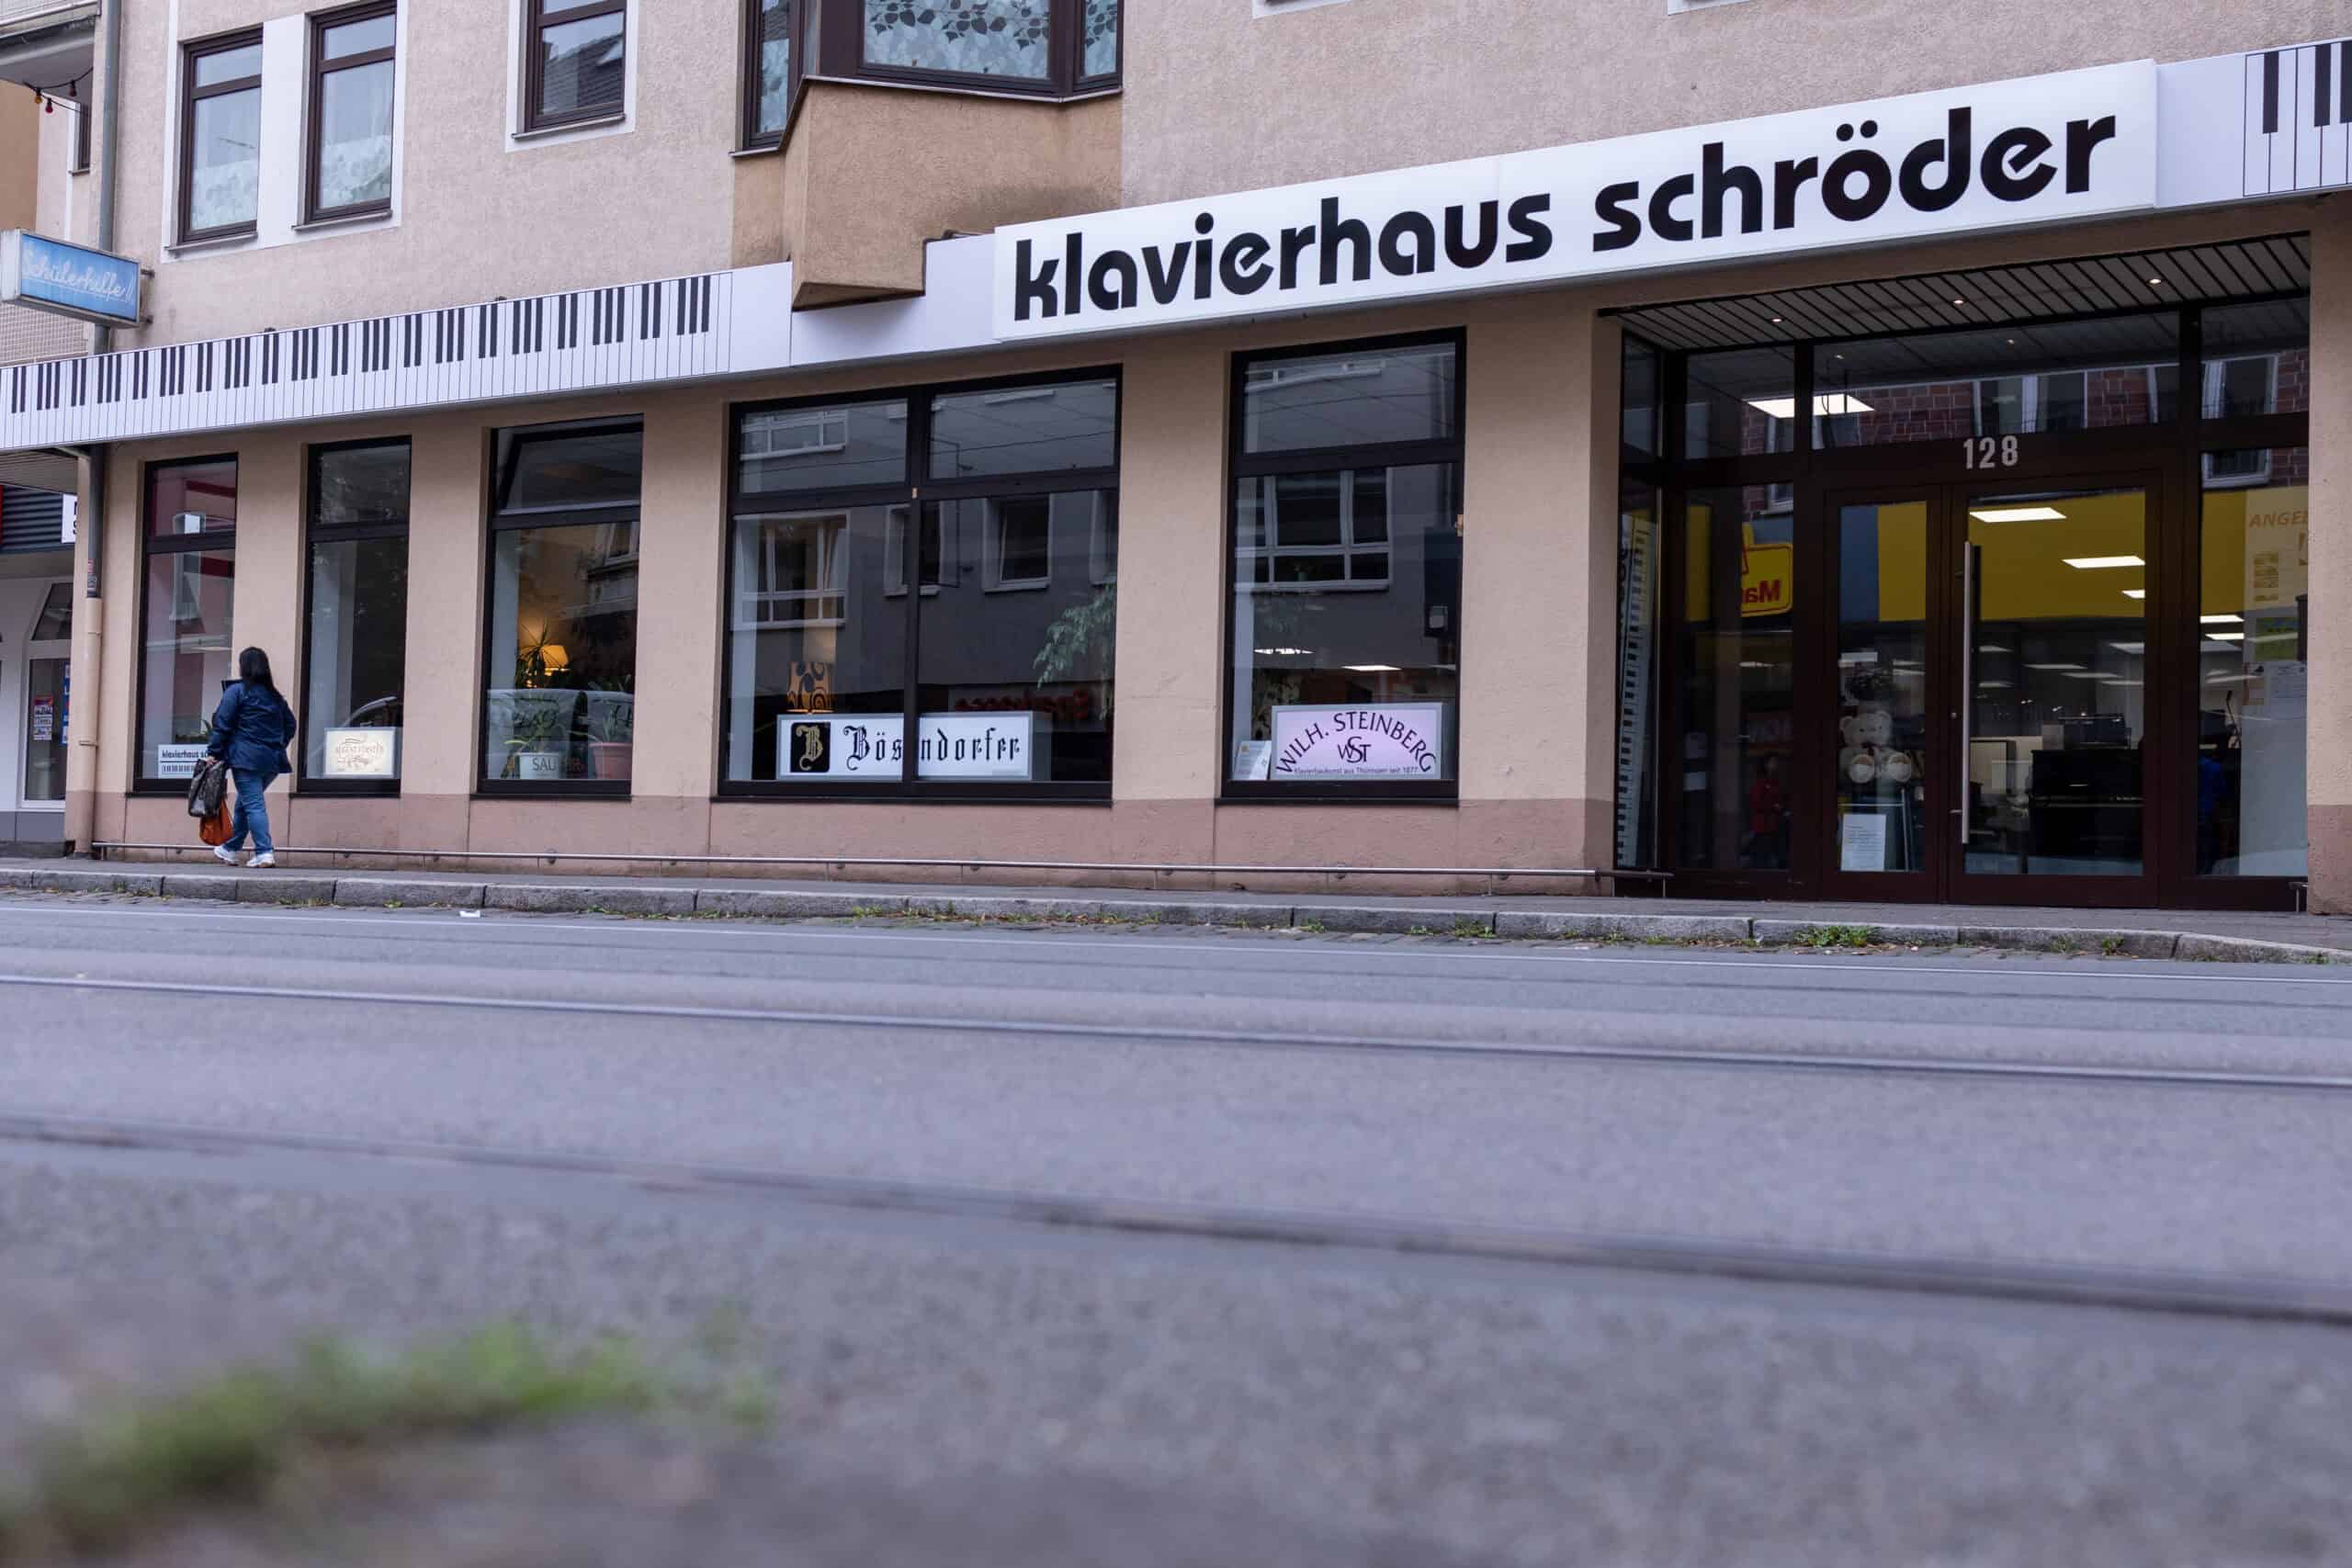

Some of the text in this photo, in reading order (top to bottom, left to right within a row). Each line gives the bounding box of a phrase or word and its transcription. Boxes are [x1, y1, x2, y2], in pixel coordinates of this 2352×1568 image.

[1013, 105, 2117, 321] klavierhaus schröder
[1962, 434, 2018, 469] 128
[162, 749, 199, 759] klavierhaus
[843, 724, 1021, 772] Bösndorfer
[1275, 711, 1437, 773] WILH. STEINBERG
